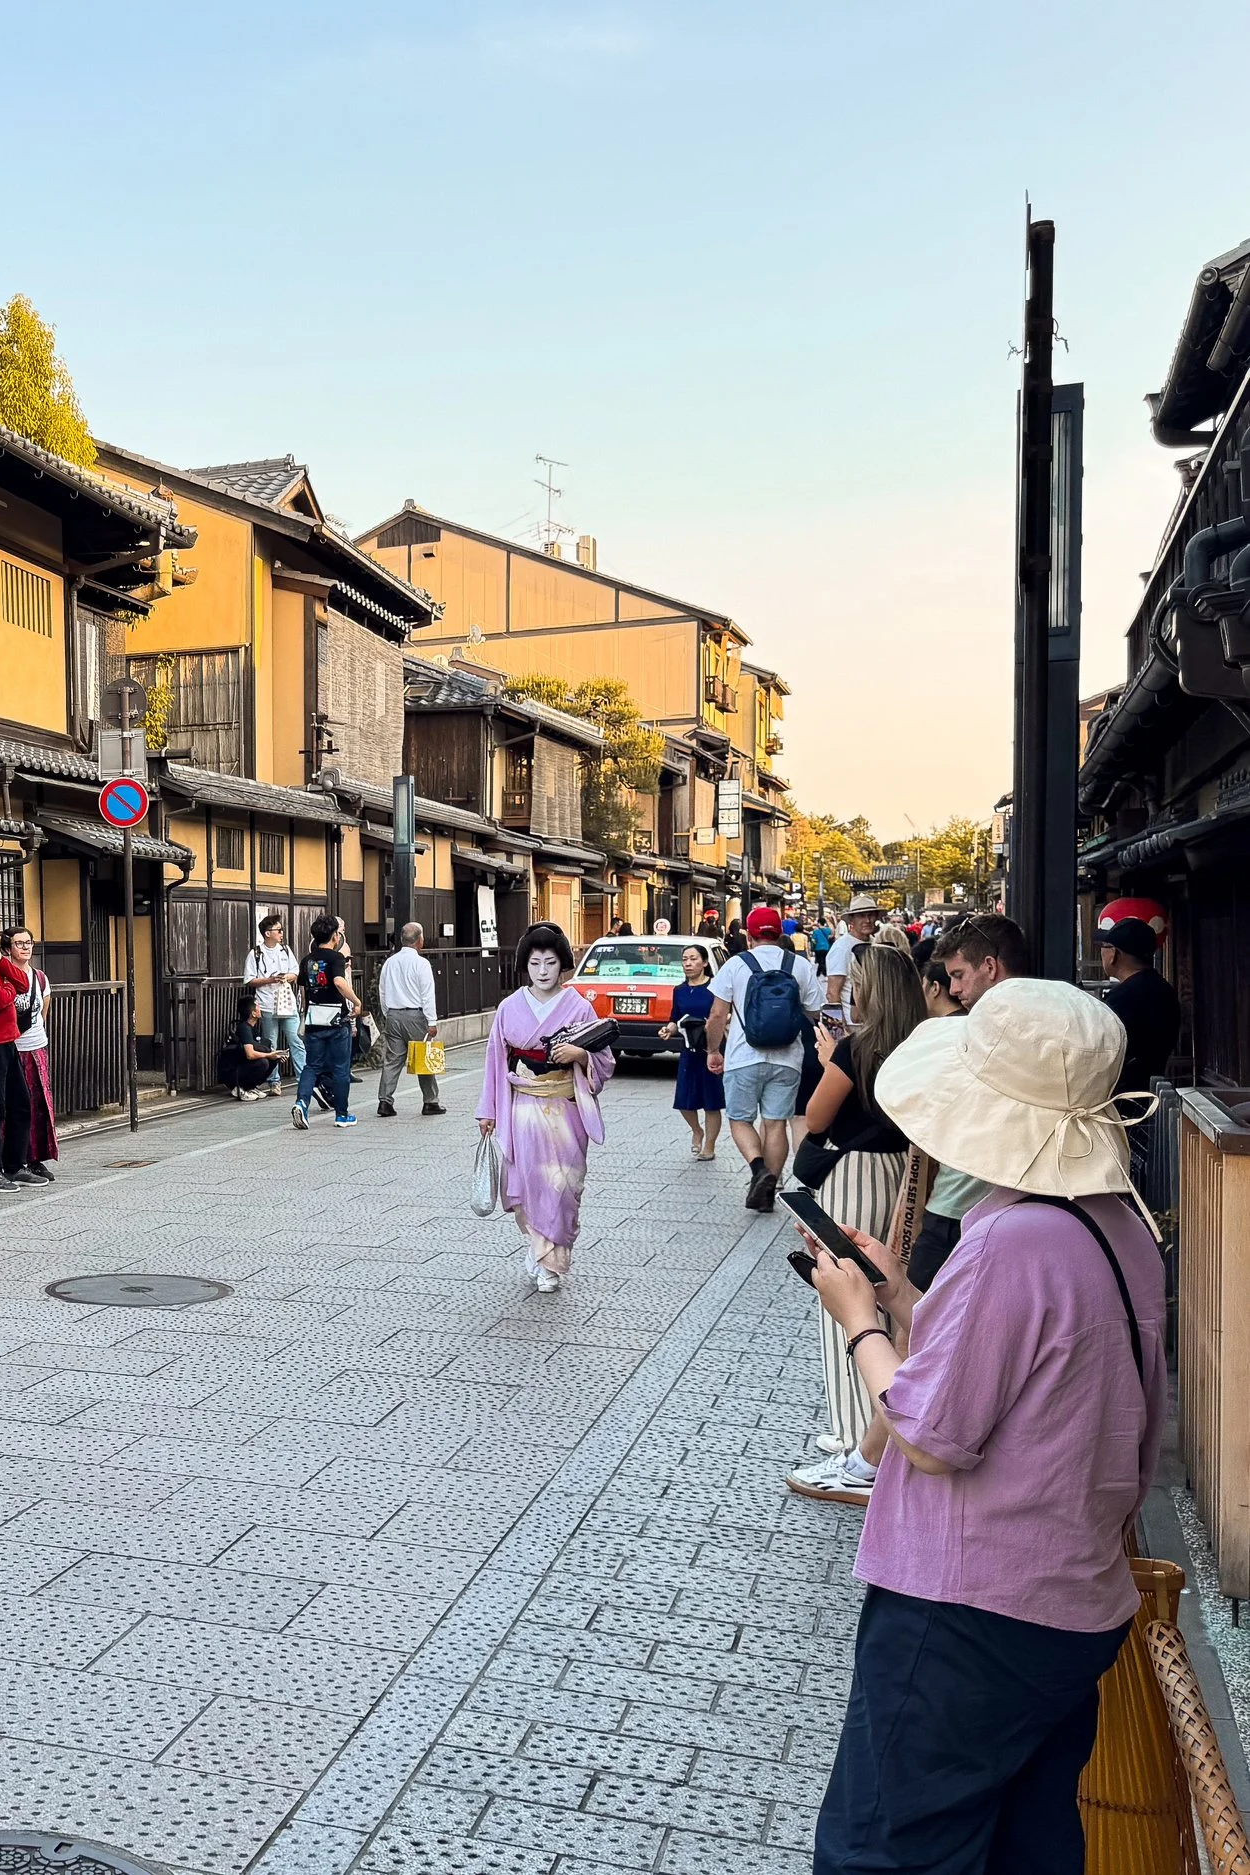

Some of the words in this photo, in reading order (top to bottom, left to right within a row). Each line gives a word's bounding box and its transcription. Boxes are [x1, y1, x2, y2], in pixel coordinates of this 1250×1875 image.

[909, 1155, 920, 1184] HOPE
[906, 1185, 917, 1205] SEE
[903, 1206, 915, 1229] YOU
